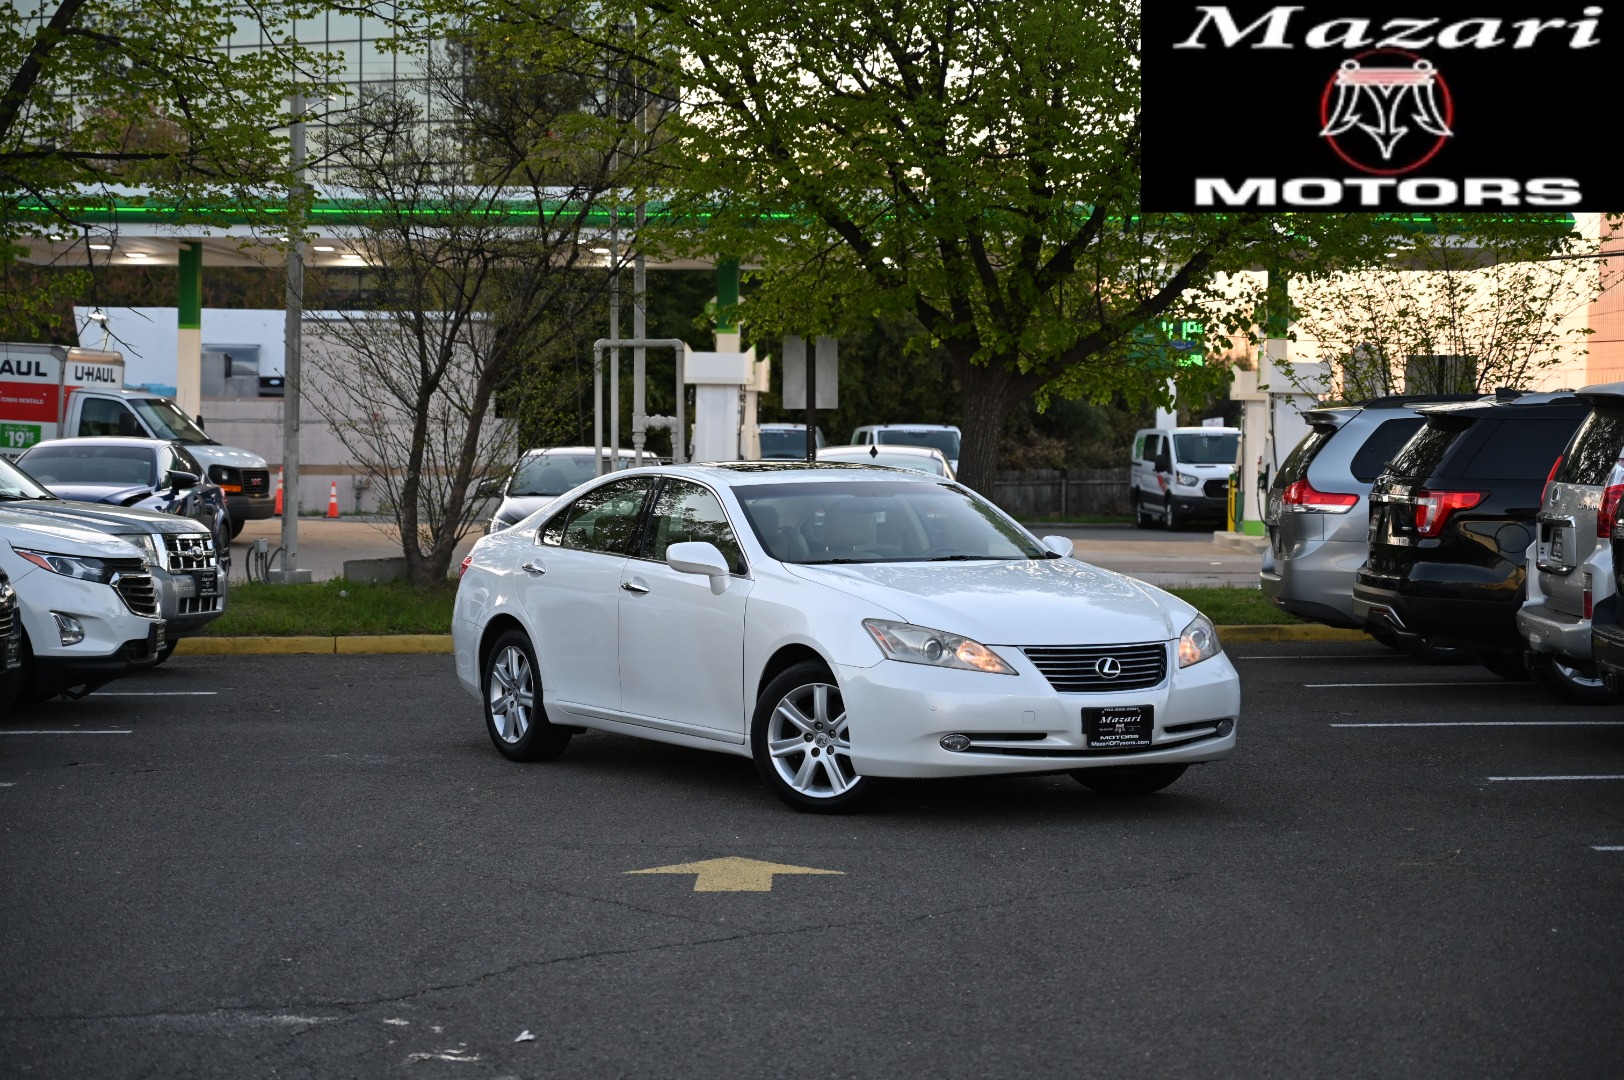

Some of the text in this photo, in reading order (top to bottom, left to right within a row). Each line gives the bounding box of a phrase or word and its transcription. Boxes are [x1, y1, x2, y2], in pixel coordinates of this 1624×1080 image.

[74, 365, 116, 383] U-HAUL
[18, 397, 44, 405] RENTALS
[1099, 715, 1141, 724] Mazari
